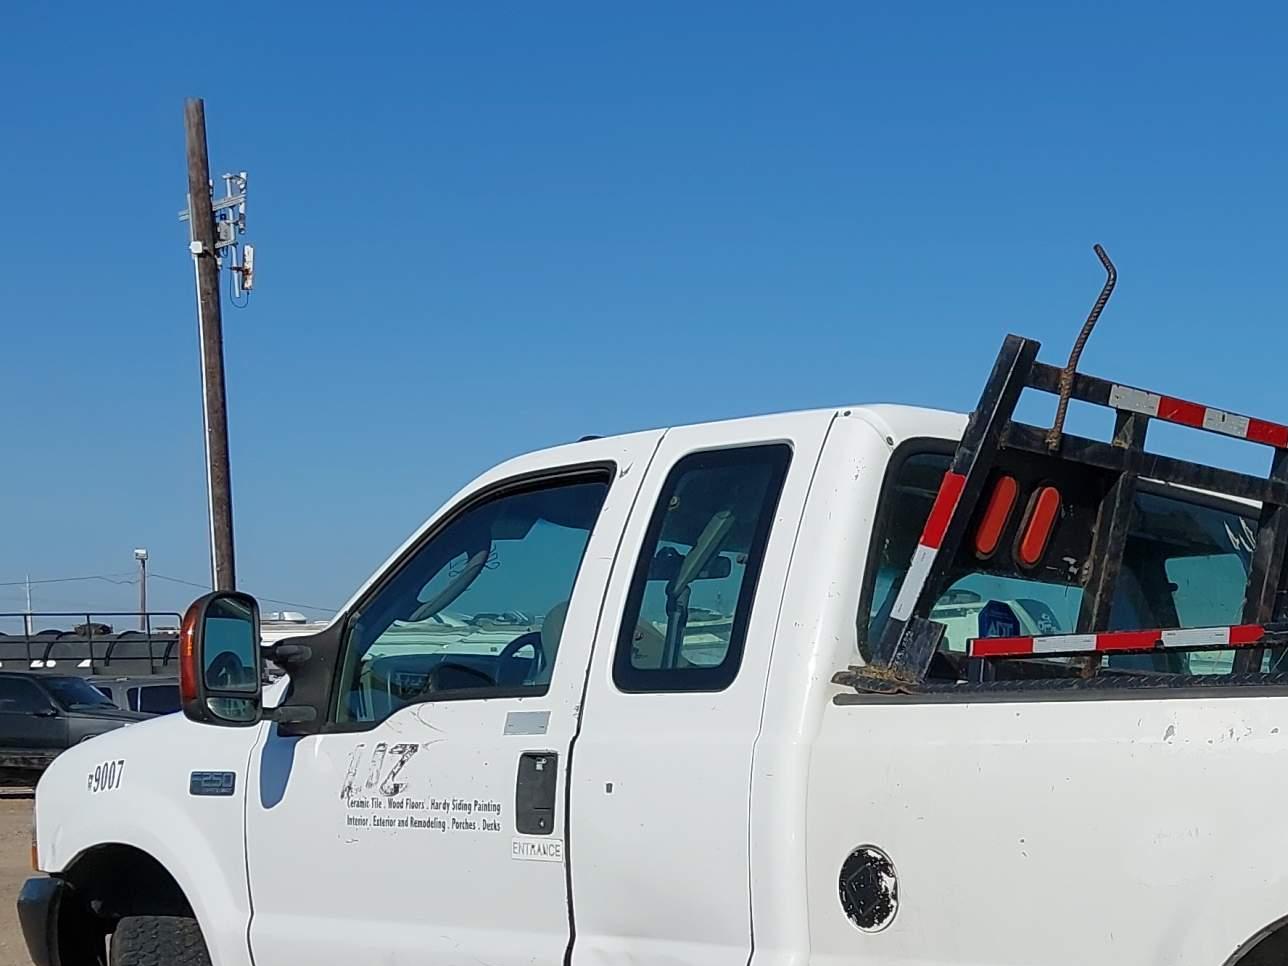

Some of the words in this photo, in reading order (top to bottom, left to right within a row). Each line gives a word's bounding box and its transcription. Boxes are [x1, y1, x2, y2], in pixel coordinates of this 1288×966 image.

[371, 798, 383, 810] Tile
[387, 798, 404, 810] Wood
[405, 798, 425, 810] Floors
[430, 799, 450, 814] Hardy
[451, 799, 472, 815] Siding
[473, 800, 501, 816] Painting
[372, 815, 397, 828] Exterior
[397, 817, 409, 828] and
[410, 816, 446, 832] Remodeling
[451, 817, 476, 830] Porches
[482, 819, 501, 831] Decks
[513, 841, 561, 857] ENTRANCE
